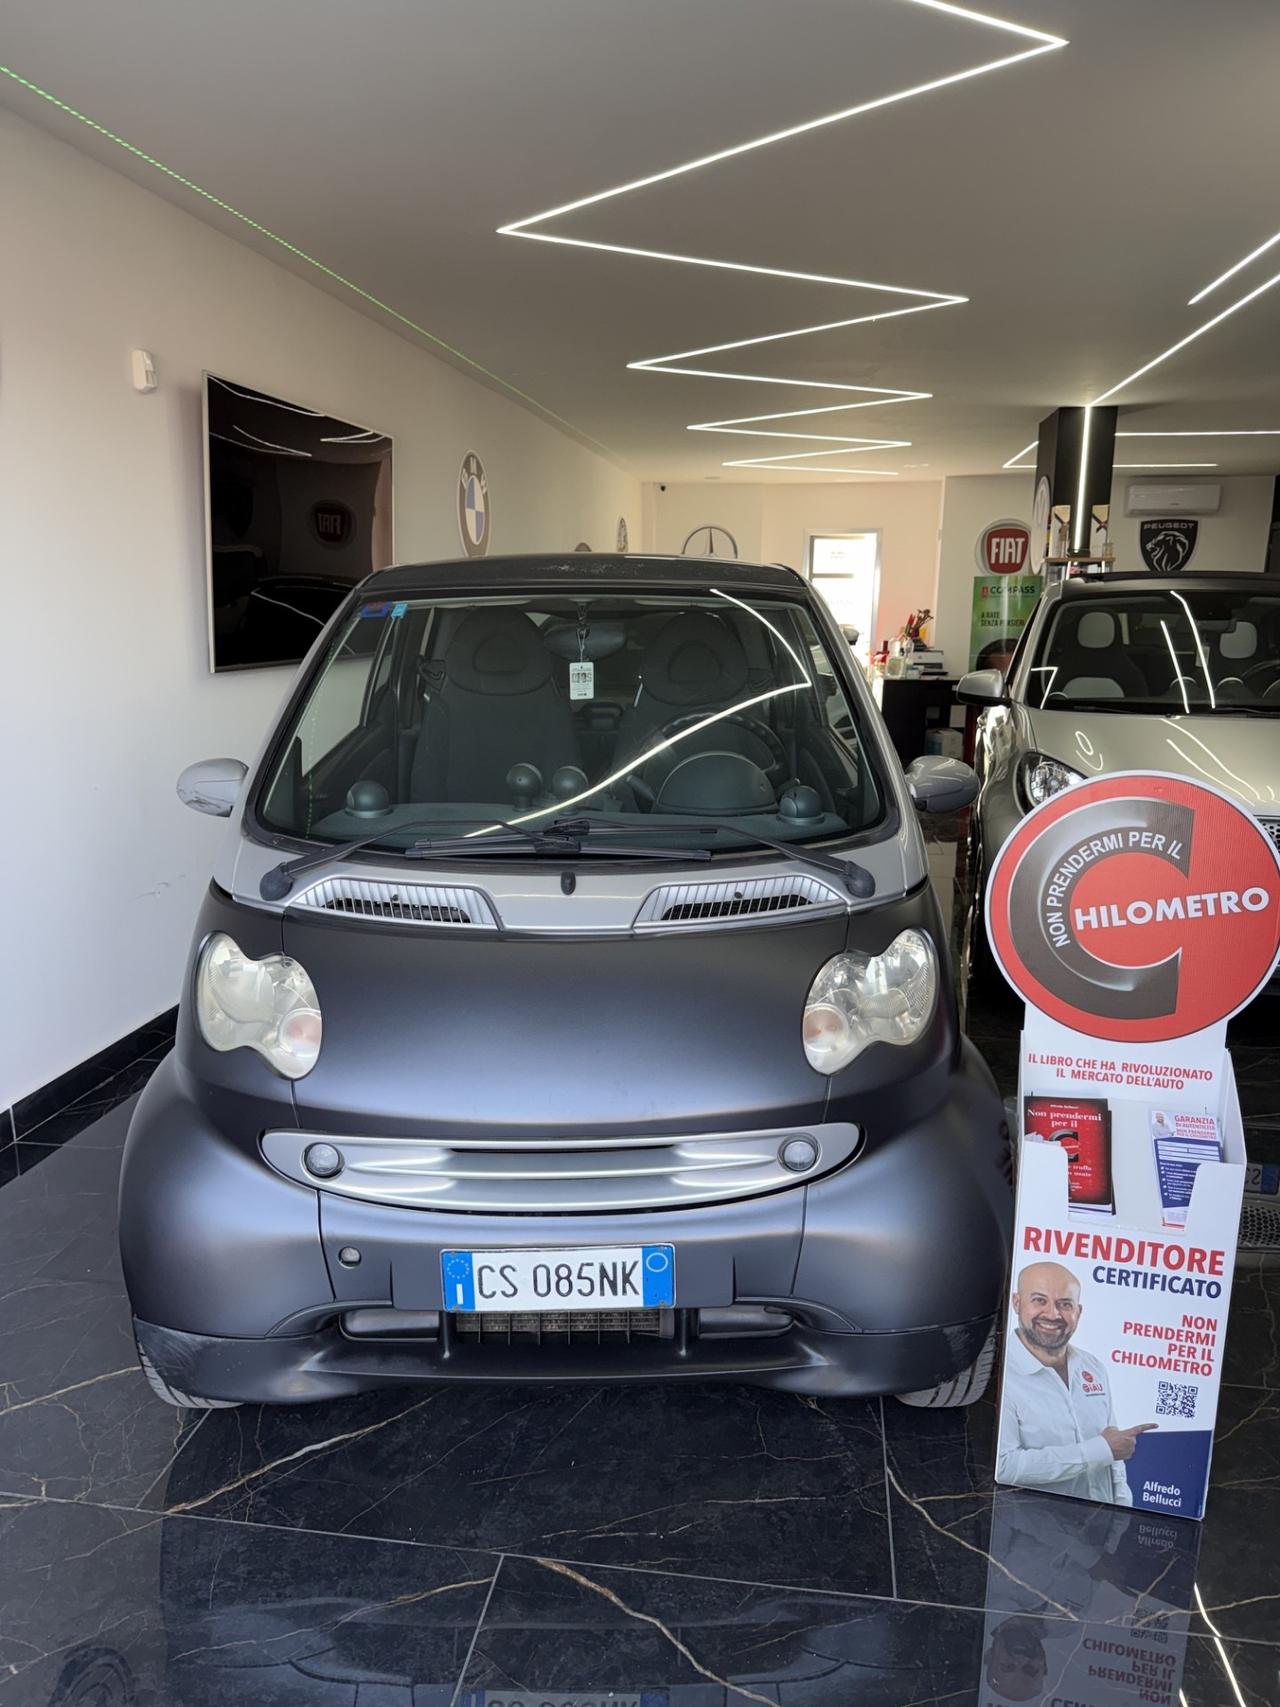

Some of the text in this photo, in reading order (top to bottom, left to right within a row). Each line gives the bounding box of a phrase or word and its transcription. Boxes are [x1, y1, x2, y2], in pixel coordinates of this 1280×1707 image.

[1143, 522, 1195, 530] PEUGEOT
[990, 537, 1028, 564] FIAT
[1046, 831, 1183, 948] NON PRENDERMI PER IL
[1028, 1053, 1213, 1081] IL LIBRO CHE HA RIVOLUZIONATO
[1056, 1068, 1185, 1090] IL MERCATO DELL'AUTO
[1028, 1108, 1102, 1121] Non prendermi
[1051, 1120, 1078, 1128] per il
[1174, 1114, 1215, 1125] GARANZIA
[1023, 1226, 1225, 1276] RIVENDITORE
[477, 1264, 518, 1299] CS
[532, 1260, 640, 1298] 085NK
[1092, 1265, 1222, 1300] CERTIFICATO
[1122, 1321, 1216, 1347] PRENDERMI
[1181, 1314, 1218, 1332] NON
[1111, 1349, 1213, 1377] CHILOMETRO
[1167, 1343, 1215, 1362] PER IL
[1143, 1480, 1182, 1496] Alfredo
[1142, 1491, 1183, 1508] Bellucci
